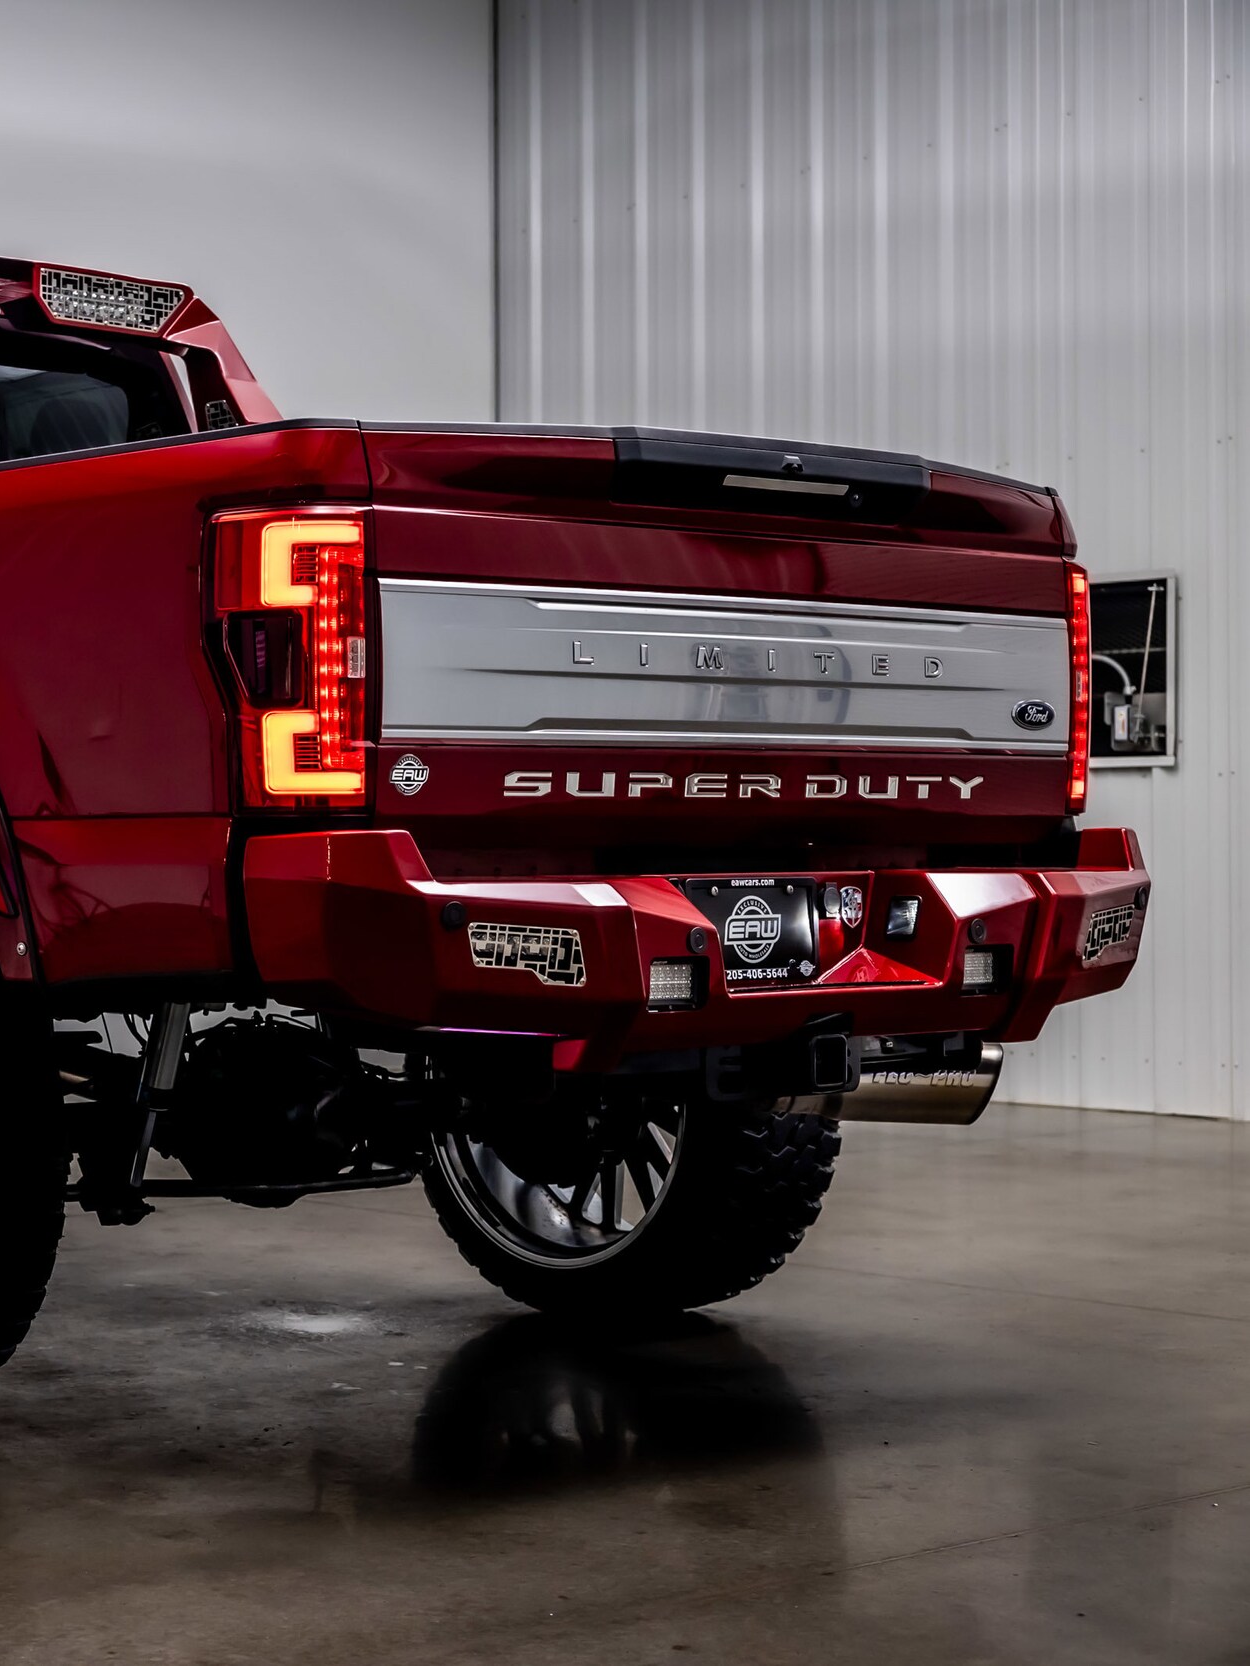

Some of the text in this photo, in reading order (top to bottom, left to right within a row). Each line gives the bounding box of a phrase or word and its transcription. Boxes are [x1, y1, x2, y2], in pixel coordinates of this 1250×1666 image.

[573, 641, 943, 679] LIMITED
[1024, 705, 1049, 723] Ford
[392, 770, 426, 780] EAW
[503, 771, 985, 799] SUPER DUTY
[729, 921, 777, 938] EAW
[727, 969, 788, 980] 205-406-5644
